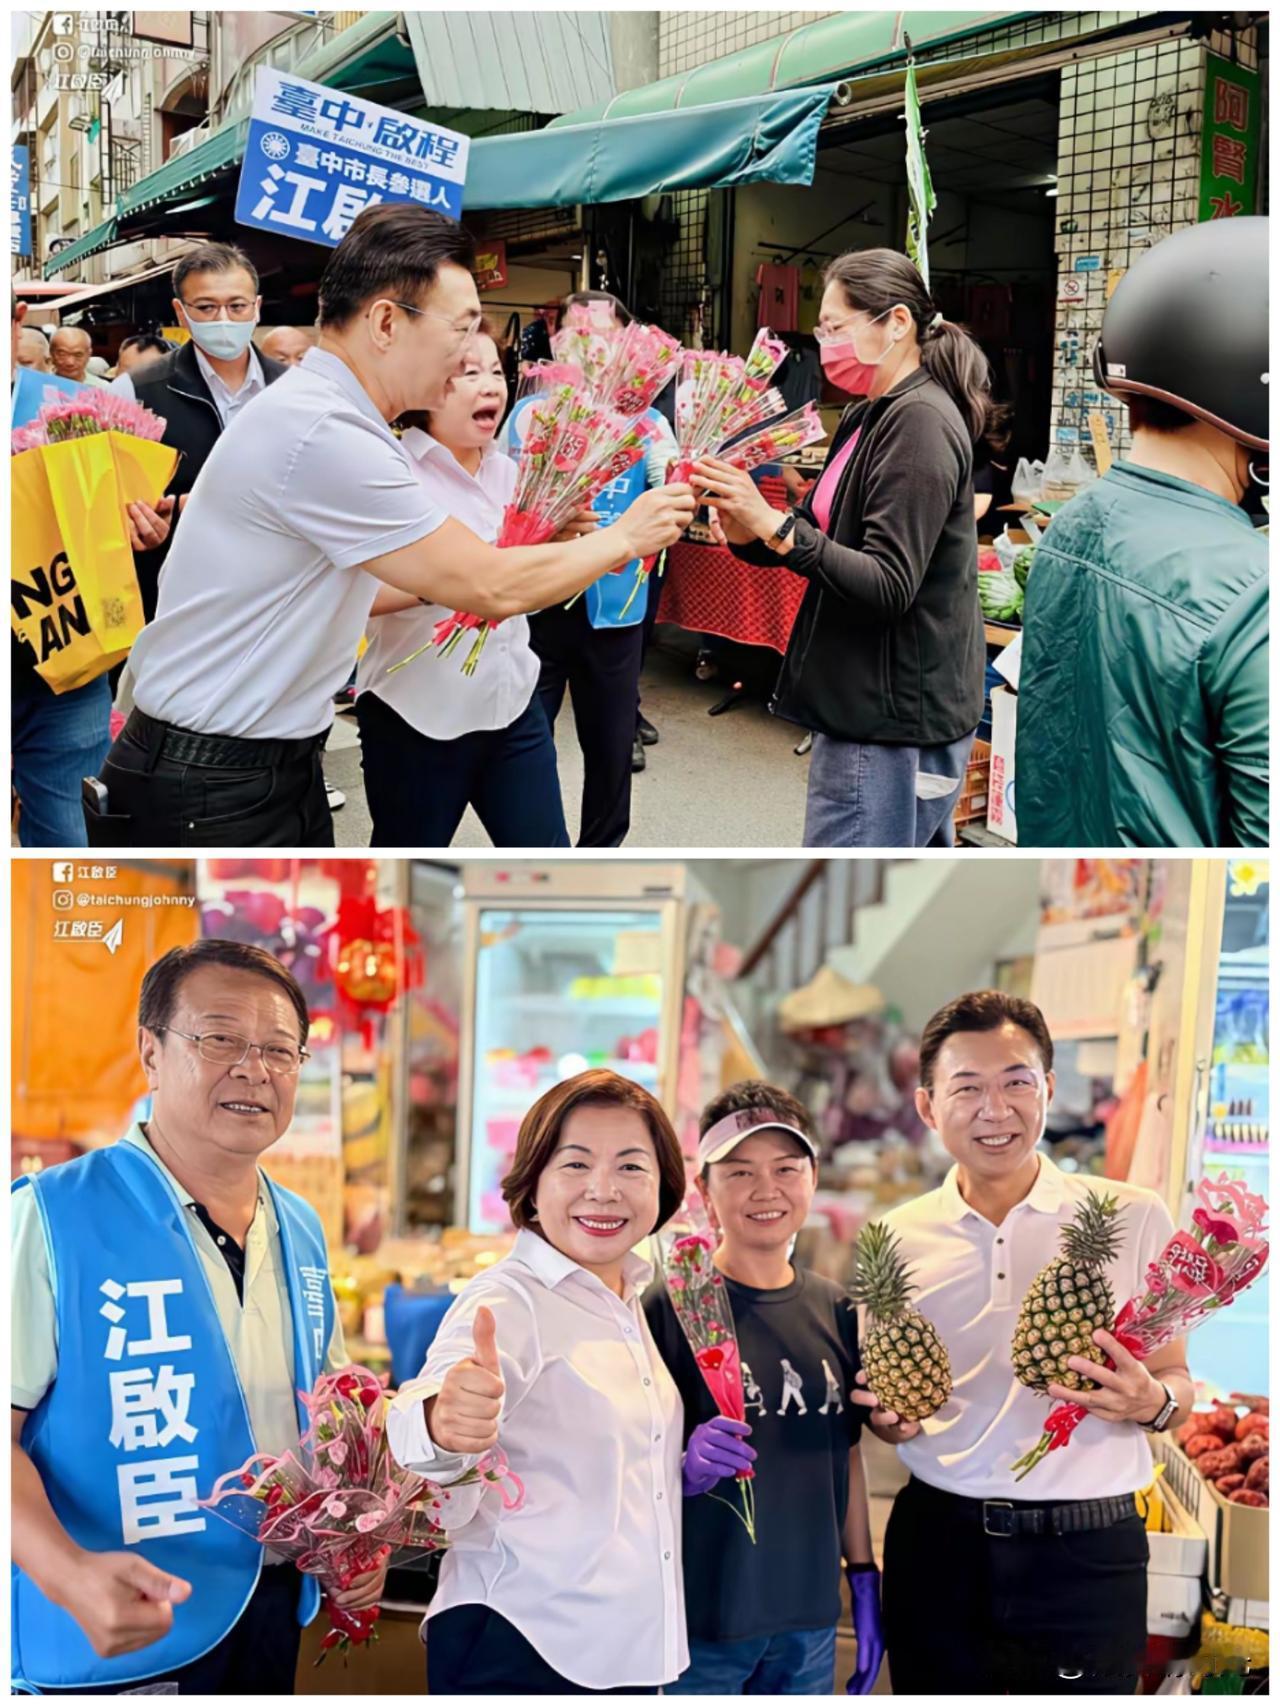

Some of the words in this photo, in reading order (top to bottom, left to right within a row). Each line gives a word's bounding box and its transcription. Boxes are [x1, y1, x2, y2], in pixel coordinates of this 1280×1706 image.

[300, 123, 330, 138] MAKE
[332, 133, 383, 155] TAICHUNG
[385, 149, 401, 161] THE
[405, 154, 429, 170] BEST
[100, 1278, 207, 1546] 江啟臣
